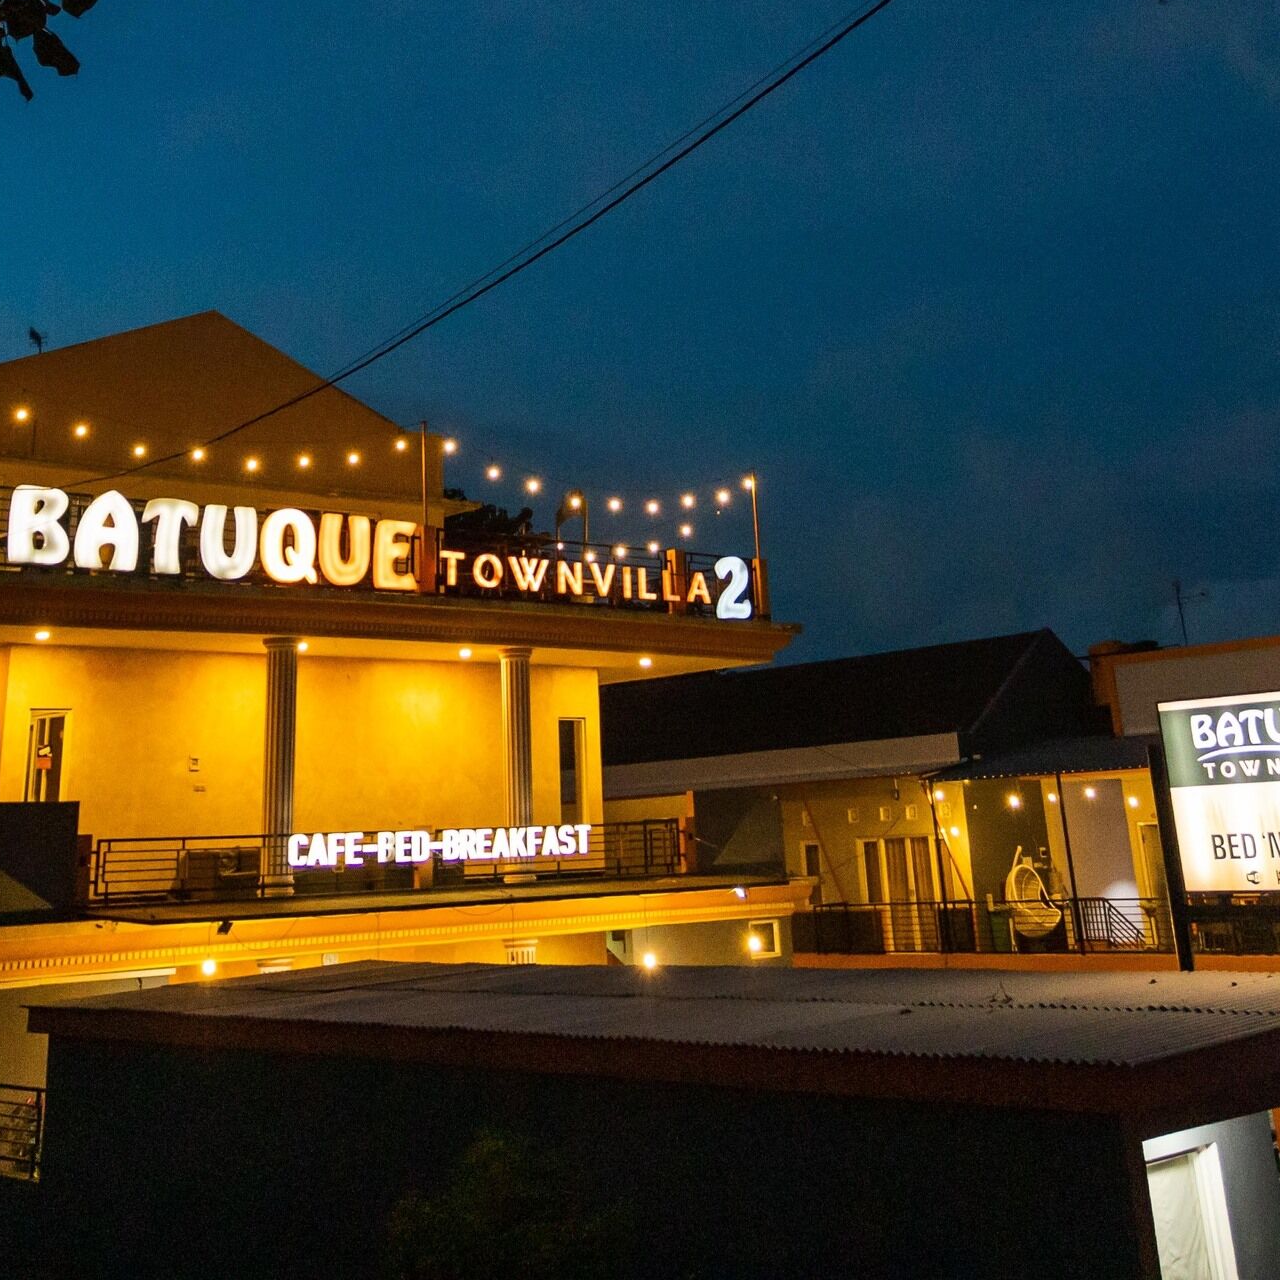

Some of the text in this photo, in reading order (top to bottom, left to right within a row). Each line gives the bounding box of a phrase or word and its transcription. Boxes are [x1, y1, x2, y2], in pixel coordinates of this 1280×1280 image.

[7, 484, 418, 590] BATUQUE
[714, 555, 753, 619] 2
[1211, 833, 1257, 860] BED
